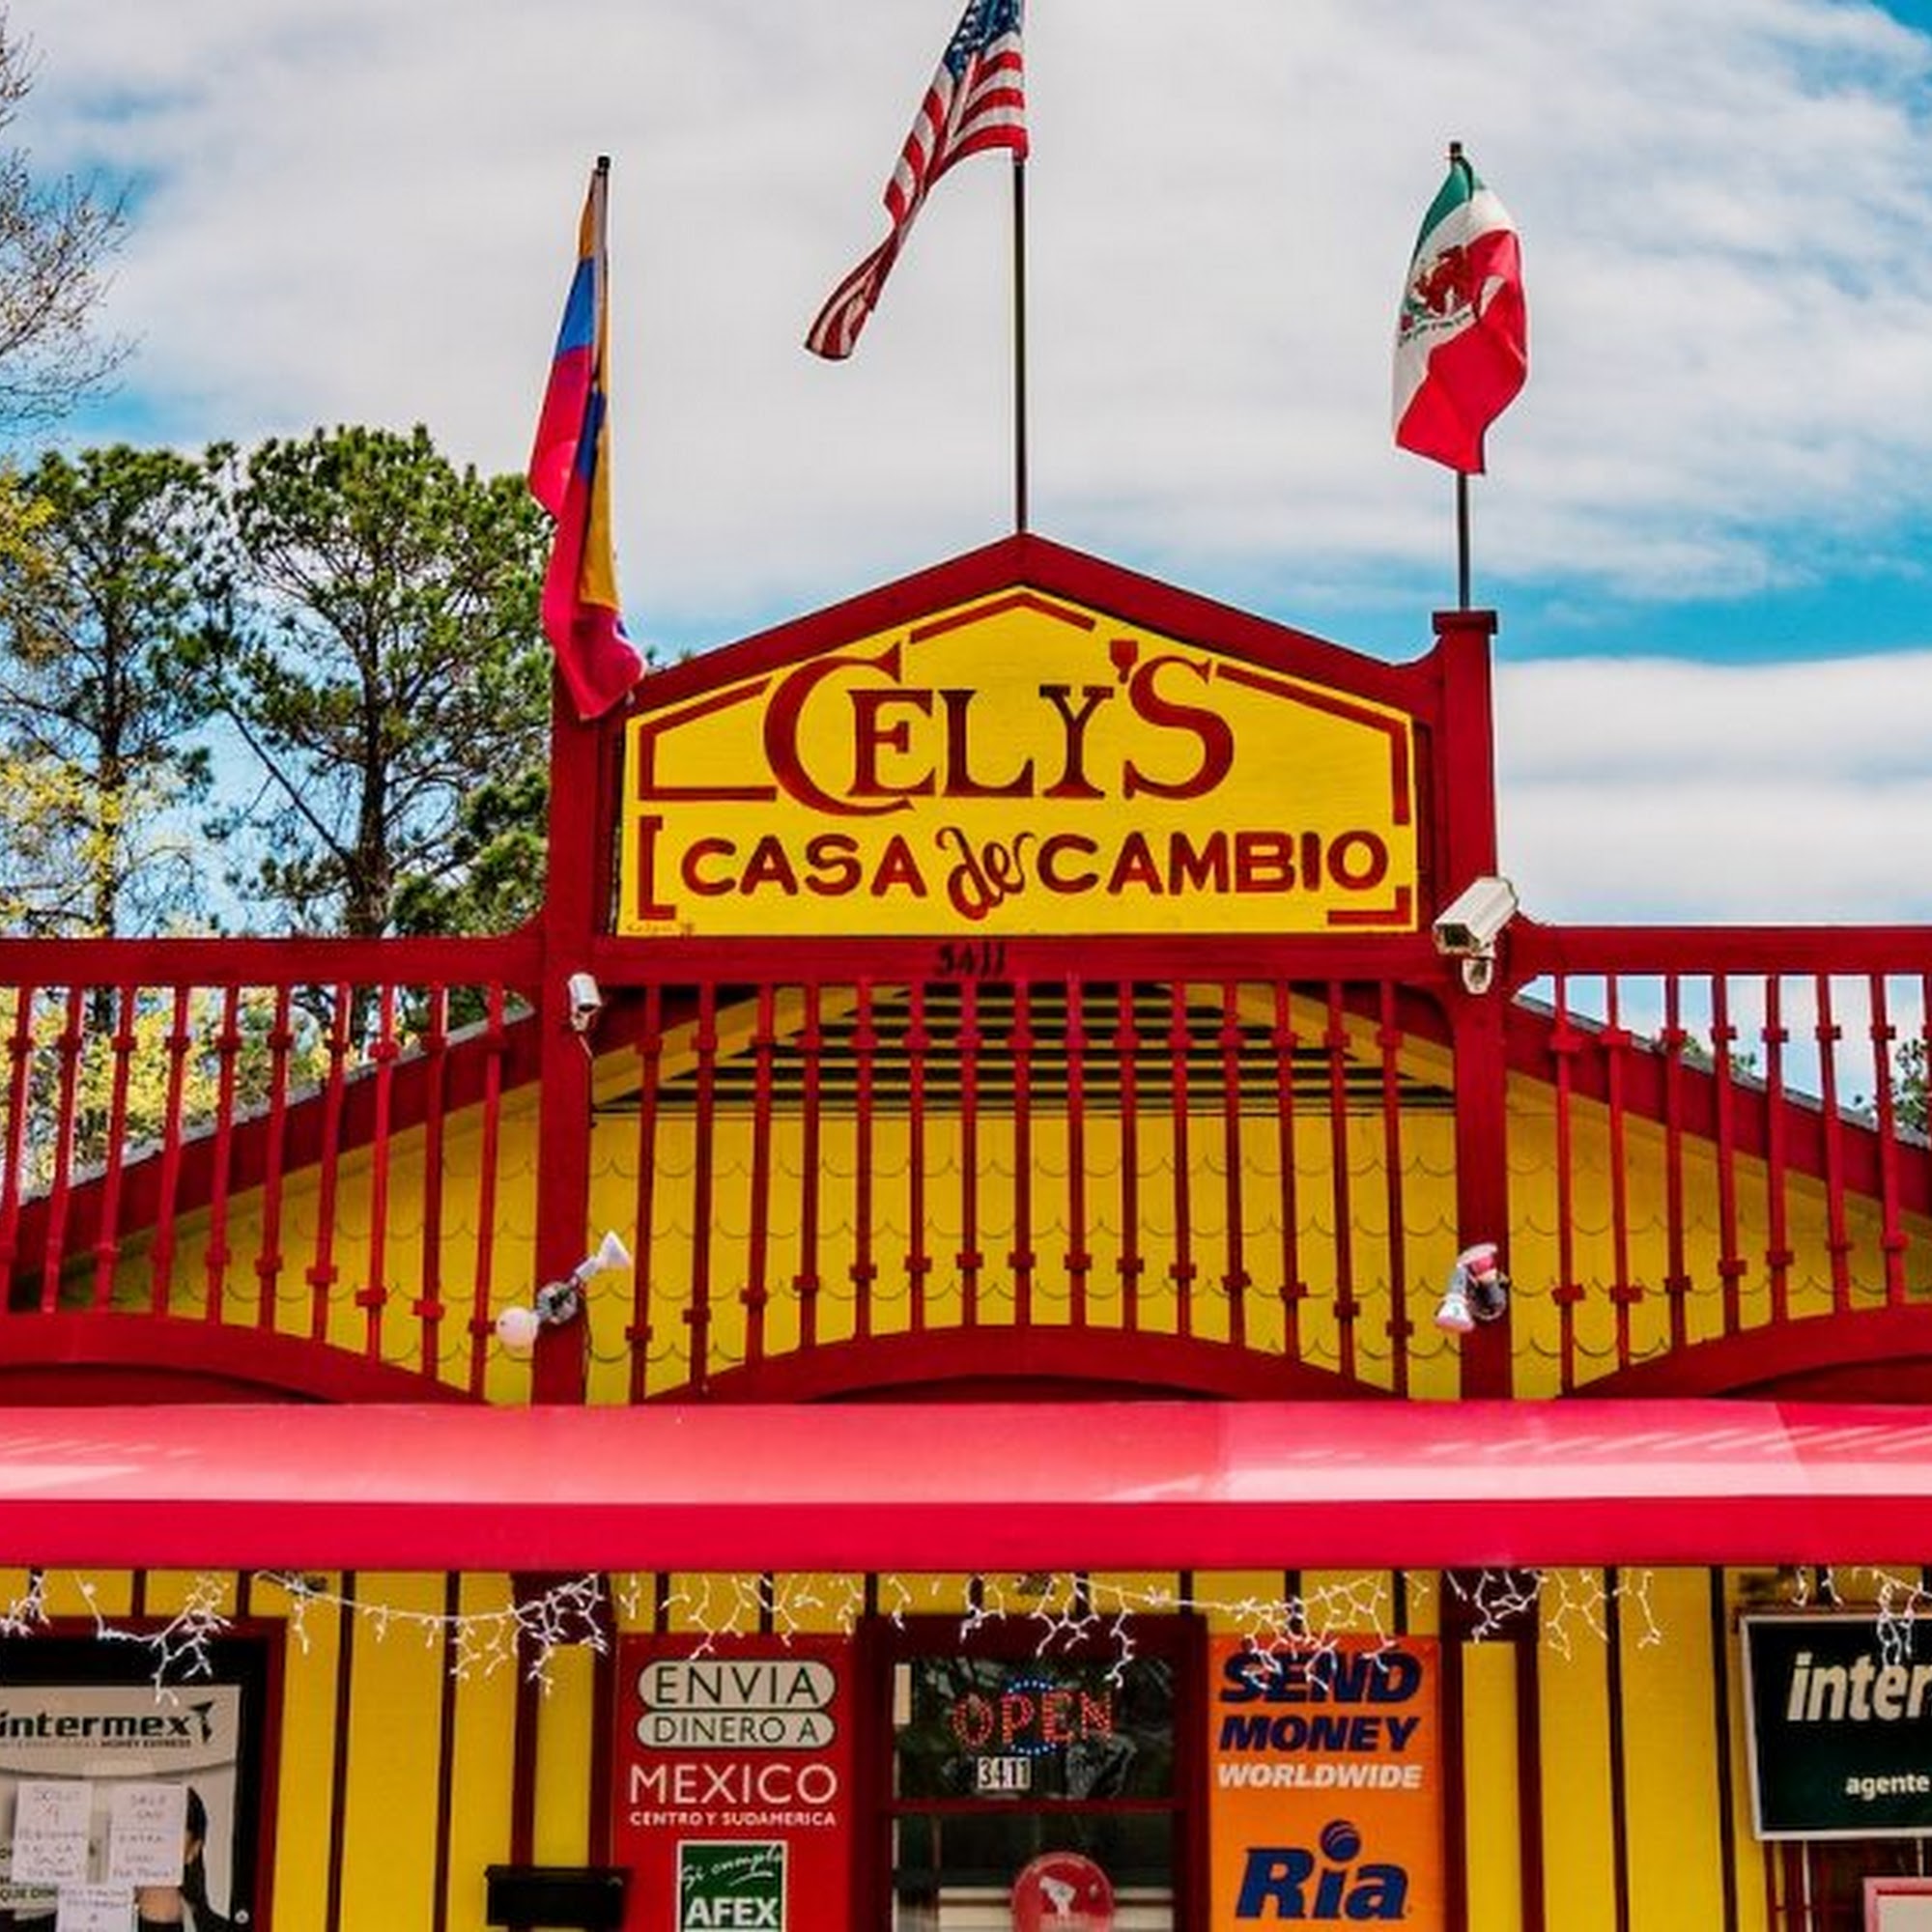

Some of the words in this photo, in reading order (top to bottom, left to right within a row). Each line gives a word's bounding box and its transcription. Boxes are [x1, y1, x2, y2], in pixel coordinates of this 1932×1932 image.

[763, 640, 1235, 817] CELY'S
[681, 833, 927, 897] CASA
[1037, 829, 1389, 895] CAMBIO
[655, 1666, 820, 1704] ENVIA
[1218, 1651, 1423, 1703] SEND
[0, 1710, 191, 1738] intermex
[653, 1716, 786, 1743] DINERO
[796, 1716, 820, 1743] A
[952, 1689, 1112, 1747] OPEN
[1218, 1716, 1420, 1752] MONEY
[629, 1763, 838, 1804] MEXICO
[980, 1758, 1029, 1787] 3411
[1217, 1763, 1424, 1788] WORLDWIDE
[1845, 1774, 1931, 1801] agente
[630, 1811, 701, 1827] CENTRO
[703, 1811, 718, 1826] Y
[722, 1810, 837, 1827] SUDAMERICA
[1235, 1820, 1408, 1919] Ria
[684, 1896, 779, 1927] AFEX
